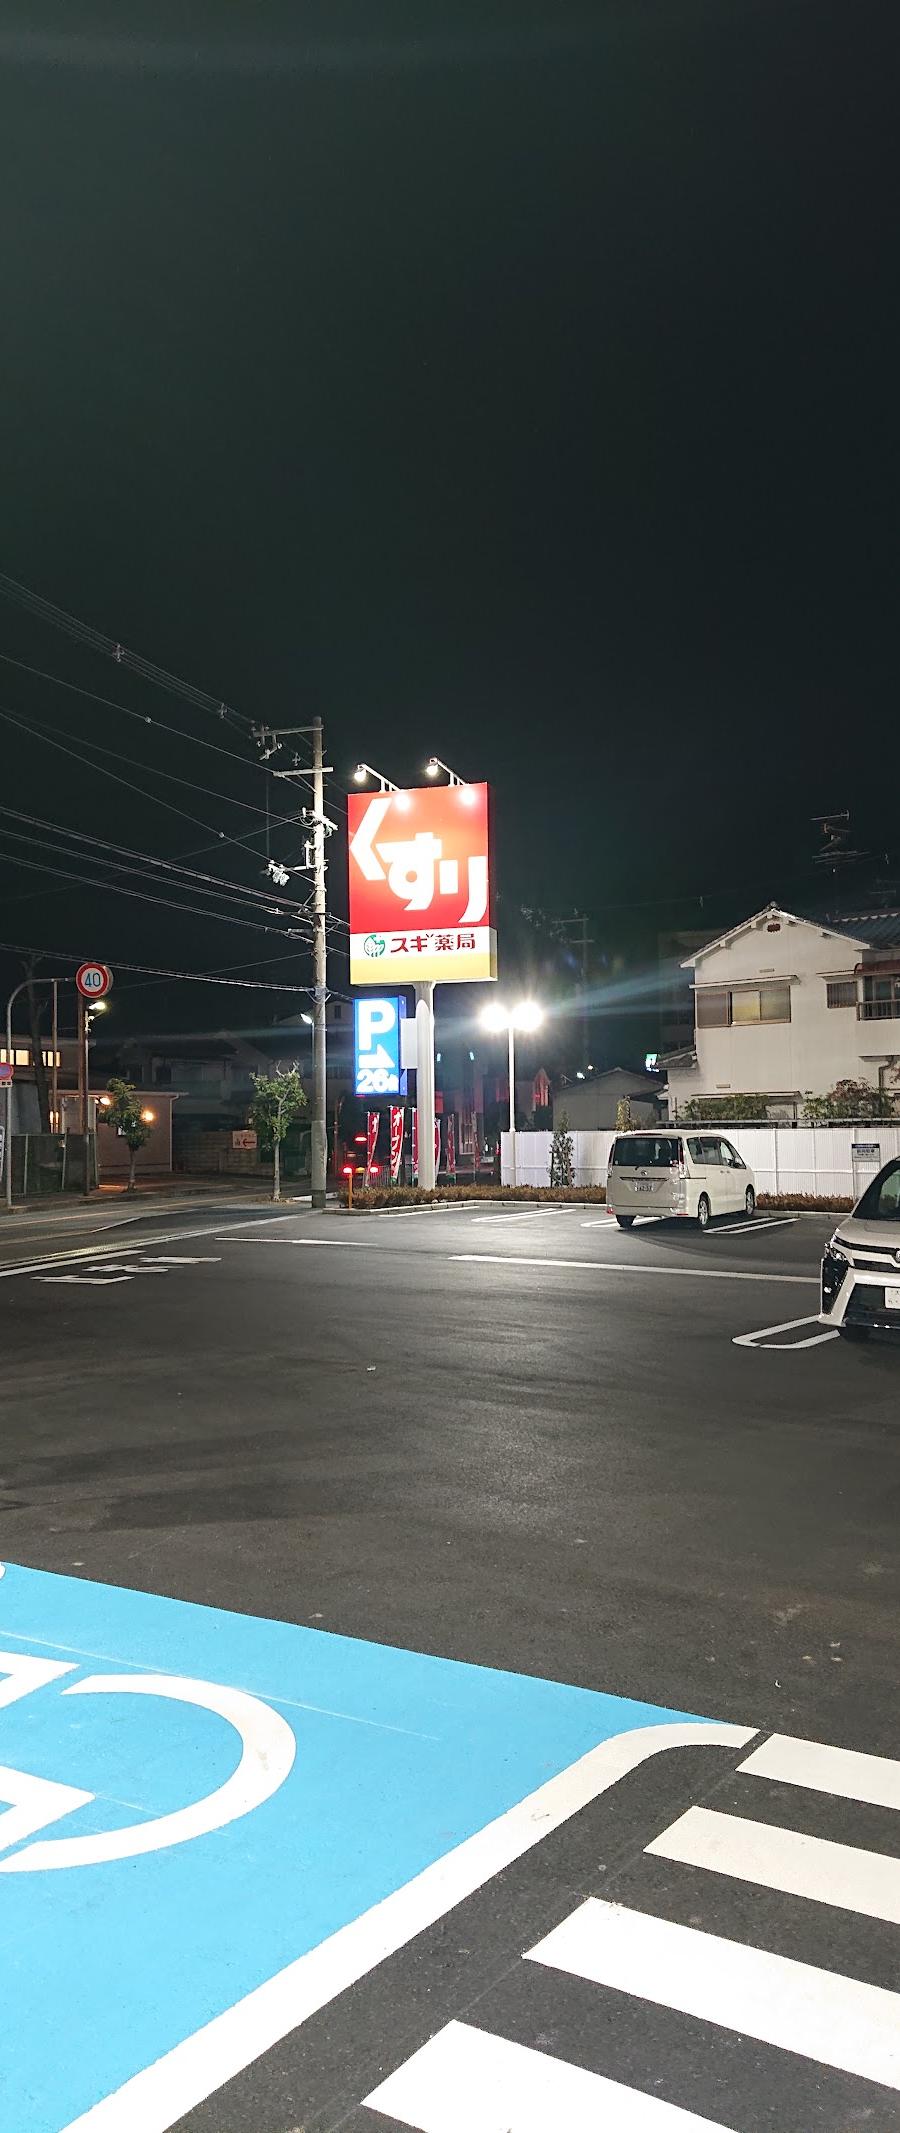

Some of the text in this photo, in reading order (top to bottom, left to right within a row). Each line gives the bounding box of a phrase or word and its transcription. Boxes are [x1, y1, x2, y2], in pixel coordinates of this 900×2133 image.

[350, 798, 489, 924] くすり
[390, 933, 476, 954] スギ薬局
[85, 972, 101, 987] 40
[358, 1000, 396, 1051] P
